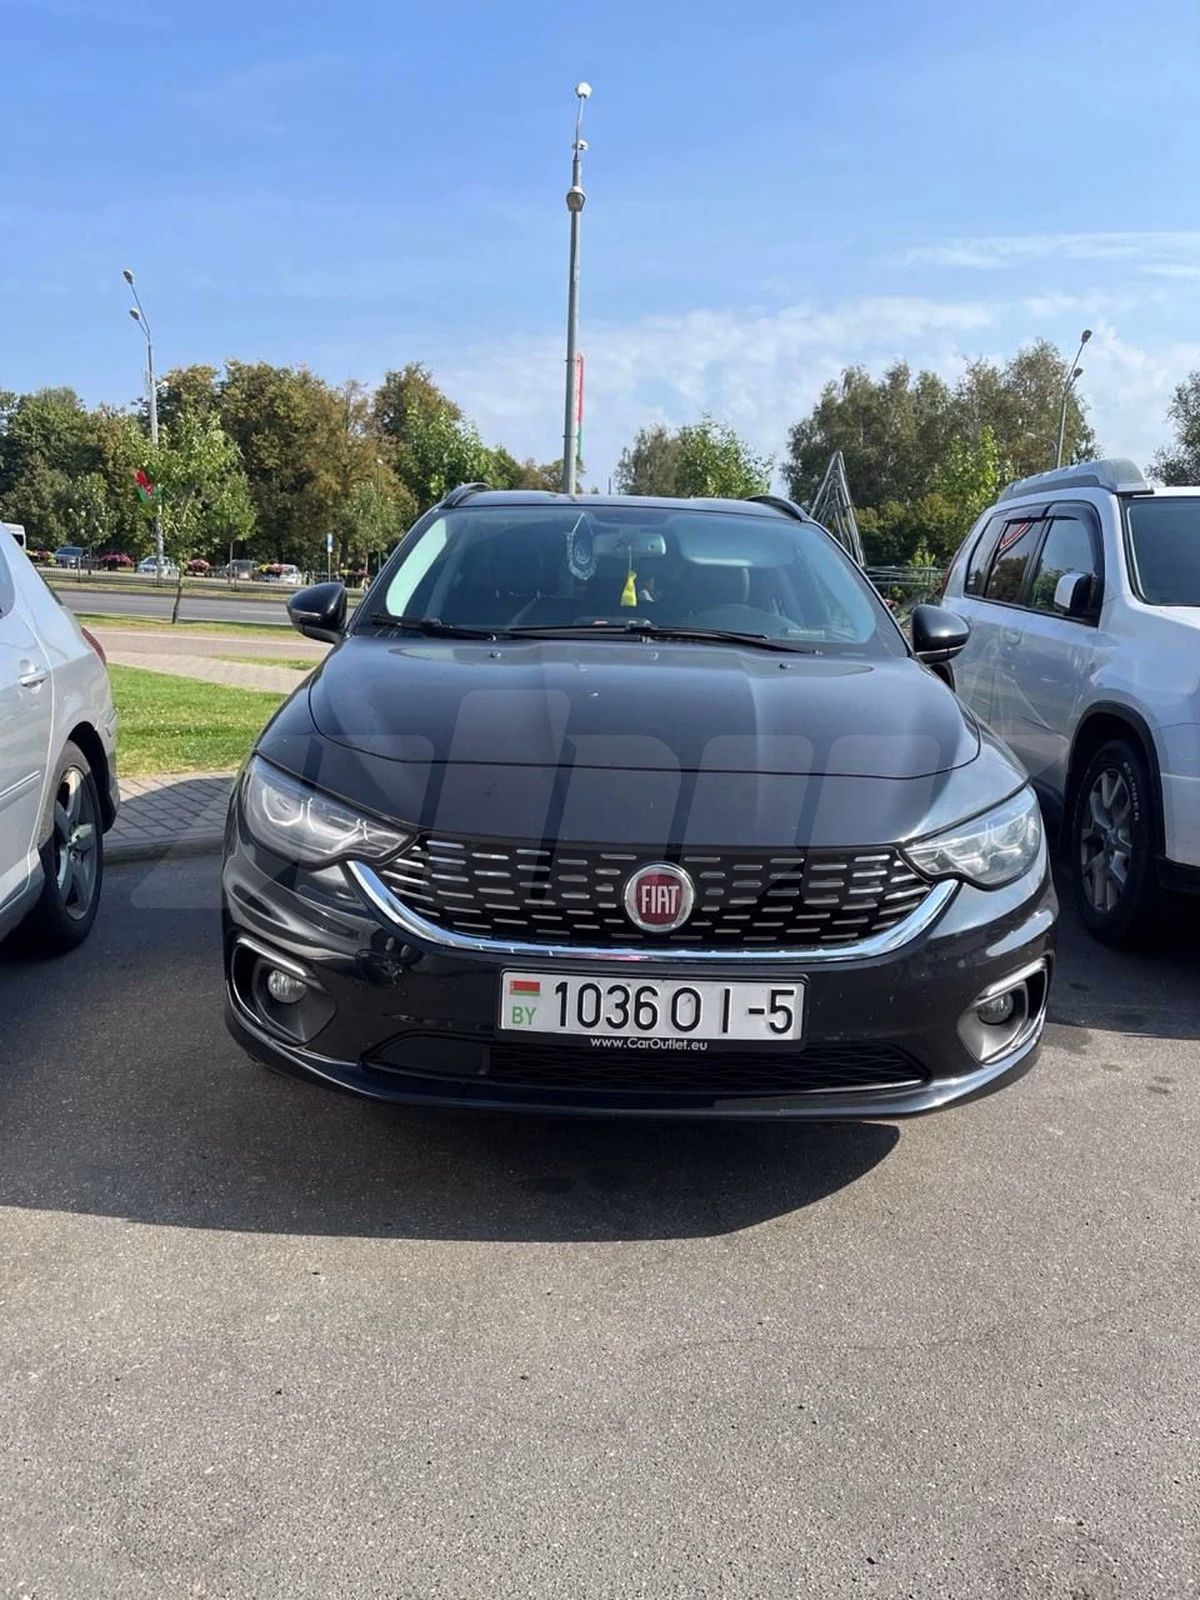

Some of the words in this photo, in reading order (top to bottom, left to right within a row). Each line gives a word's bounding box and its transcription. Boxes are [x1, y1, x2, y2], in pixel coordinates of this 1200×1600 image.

[641, 885, 680, 914] FIAT
[511, 1006, 537, 1026] BY
[590, 1036, 708, 1051] www.CarOutlet.eu
